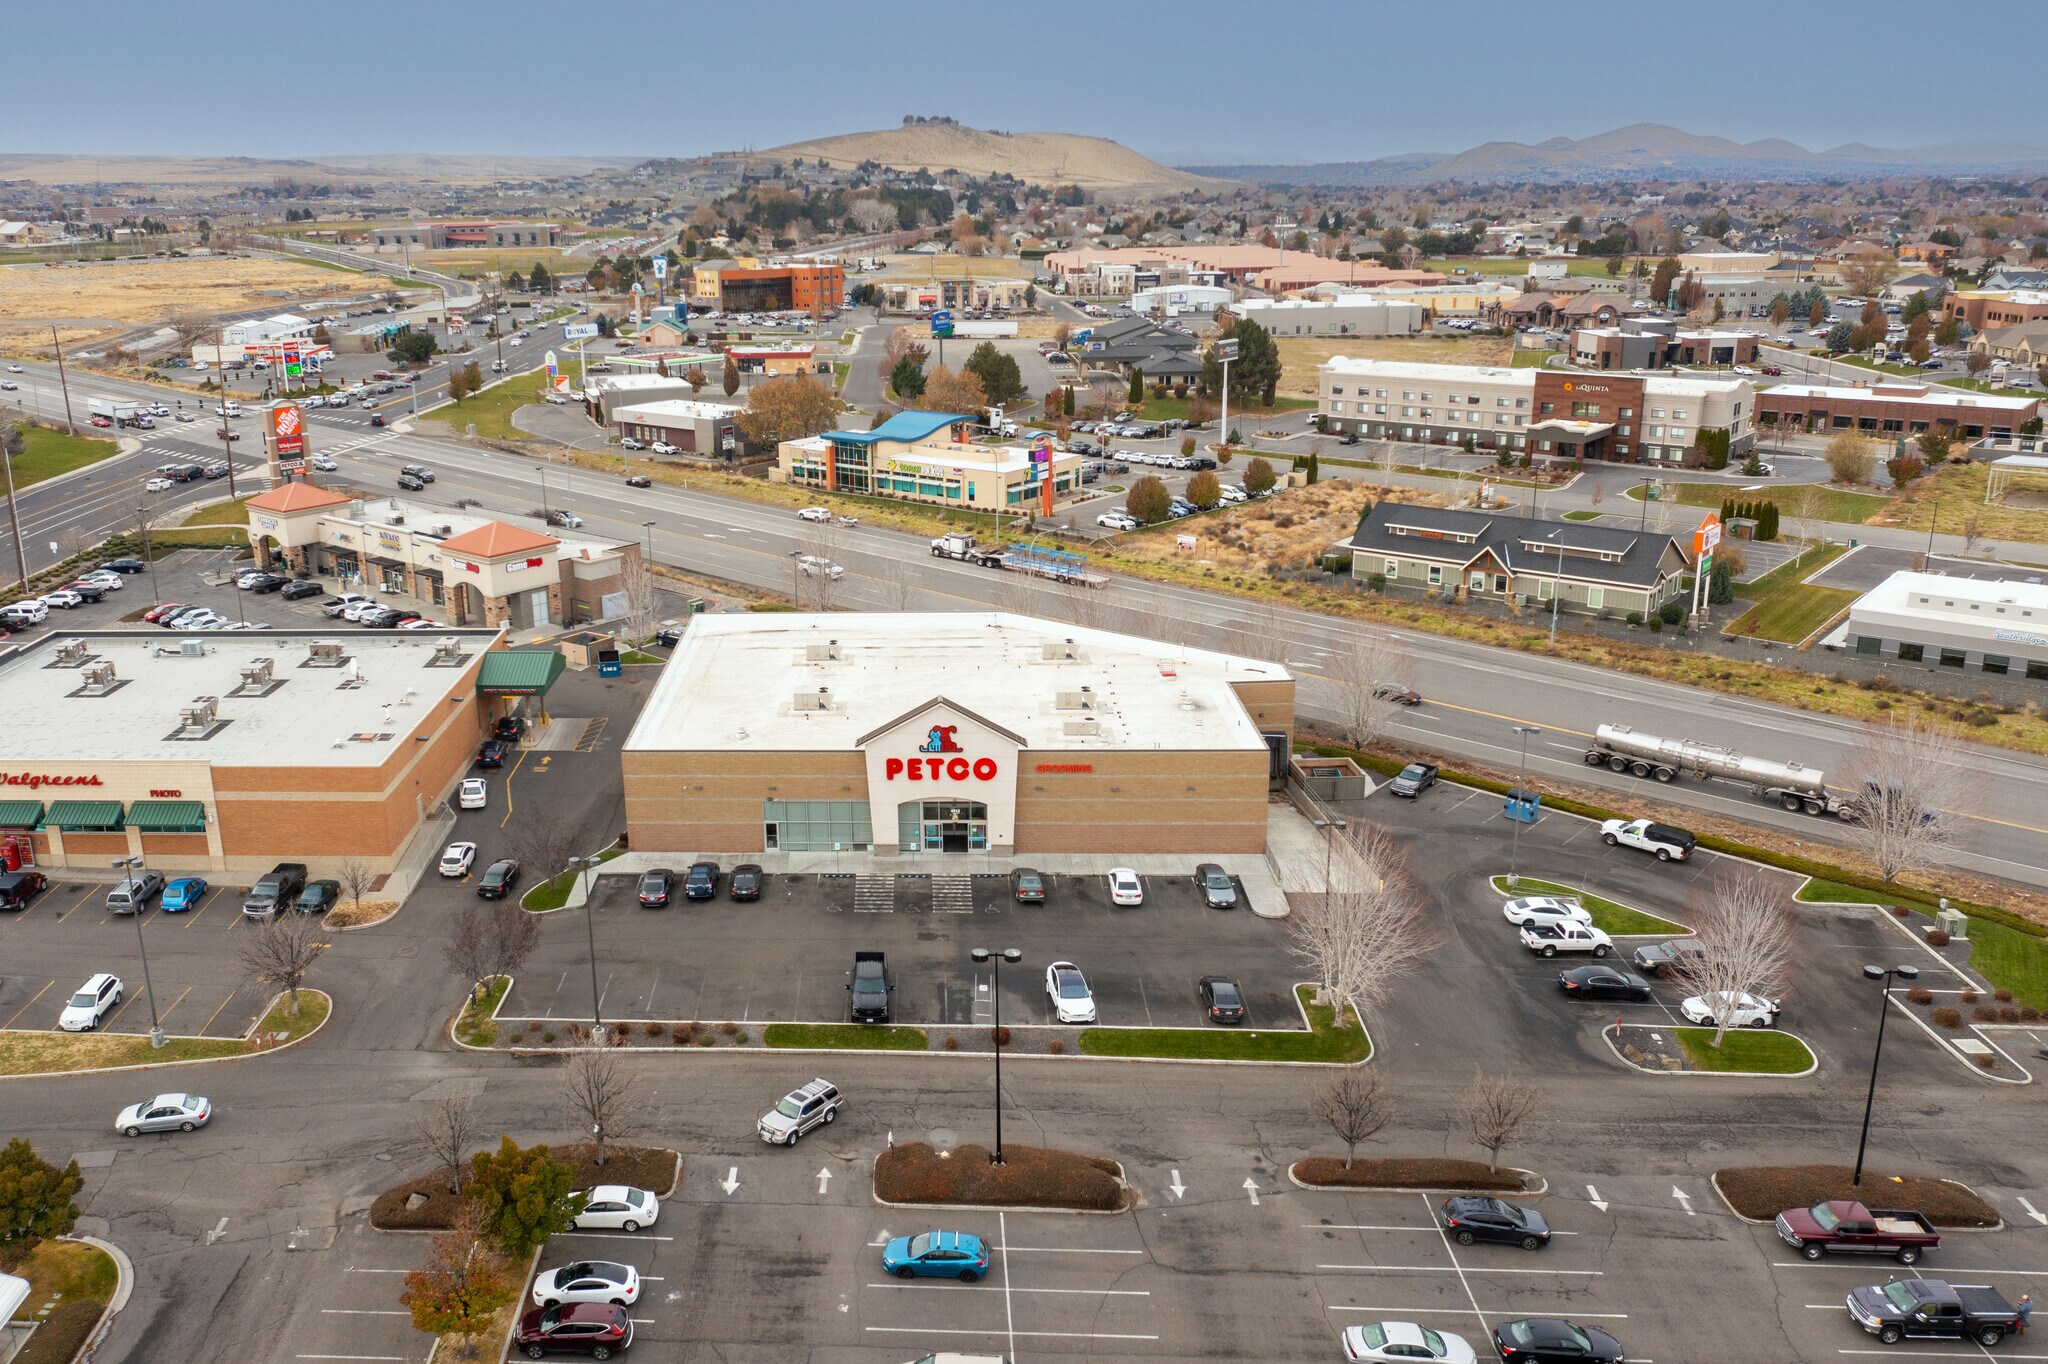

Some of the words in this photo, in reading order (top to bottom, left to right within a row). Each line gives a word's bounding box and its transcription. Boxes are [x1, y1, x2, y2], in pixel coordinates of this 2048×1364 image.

[276, 407, 299, 435] HOME
[278, 411, 288, 422] THE
[286, 417, 300, 435] DEPOT
[506, 557, 543, 573] GameStop
[886, 757, 998, 781] PETCO
[1035, 763, 1093, 773] GROOMING
[150, 789, 182, 798] PHOTO
